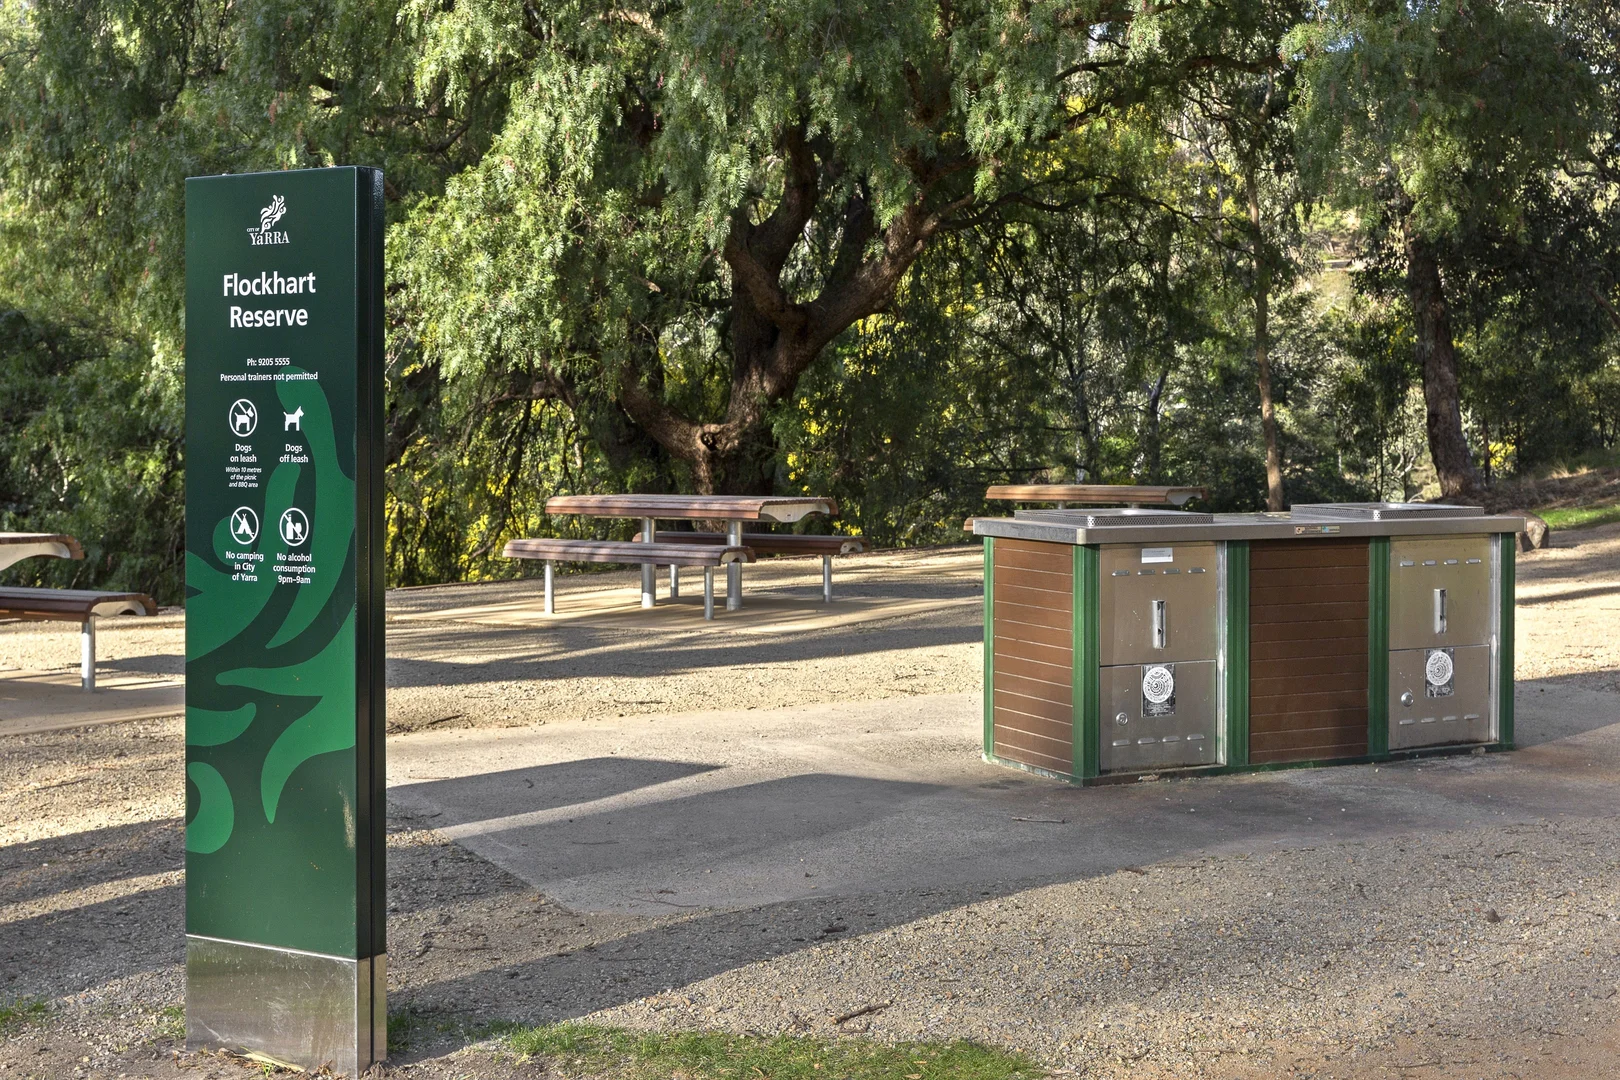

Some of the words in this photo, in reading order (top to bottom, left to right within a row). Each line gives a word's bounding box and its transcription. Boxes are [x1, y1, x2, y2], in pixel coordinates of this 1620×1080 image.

[224, 271, 316, 296] Flockhart
[230, 306, 308, 328] Reserve
[220, 373, 246, 382] Personal
[248, 373, 272, 381] trainers
[286, 372, 318, 381] permitted
[235, 444, 252, 452] Dogs
[286, 444, 302, 452] Dogs
[237, 552, 264, 561] camping
[242, 563, 255, 572] City
[273, 565, 315, 573] consumption
